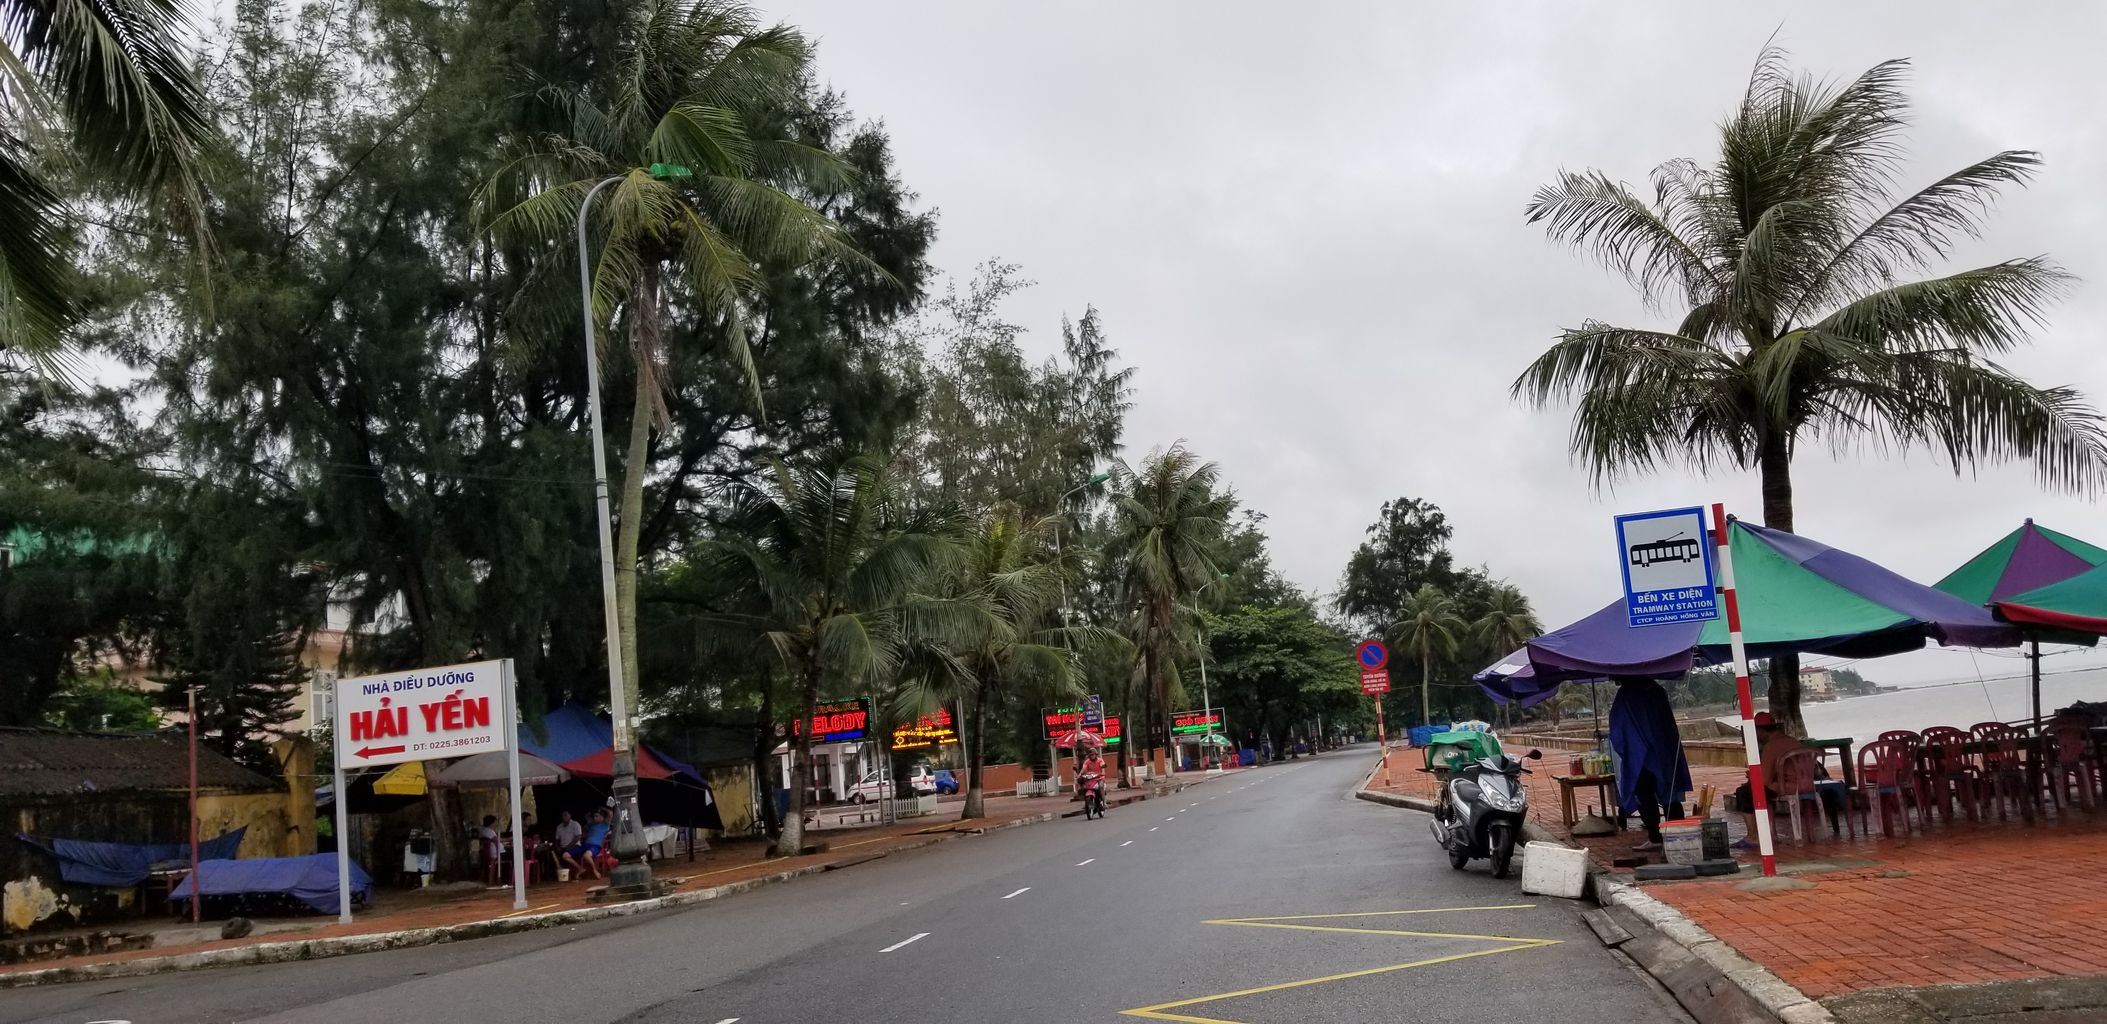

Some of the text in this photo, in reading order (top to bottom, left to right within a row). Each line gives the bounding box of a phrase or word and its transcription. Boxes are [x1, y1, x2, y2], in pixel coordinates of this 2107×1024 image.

[1637, 591, 1658, 604] BẾN
[1662, 592, 1676, 602] XE
[1632, 600, 1713, 615] TRAMWAY STATION
[362, 672, 475, 695] NHÀ ĐIỀU DƯỠNG
[349, 688, 490, 742] HẢI YẾN
[429, 735, 491, 750] 0225.3861203
